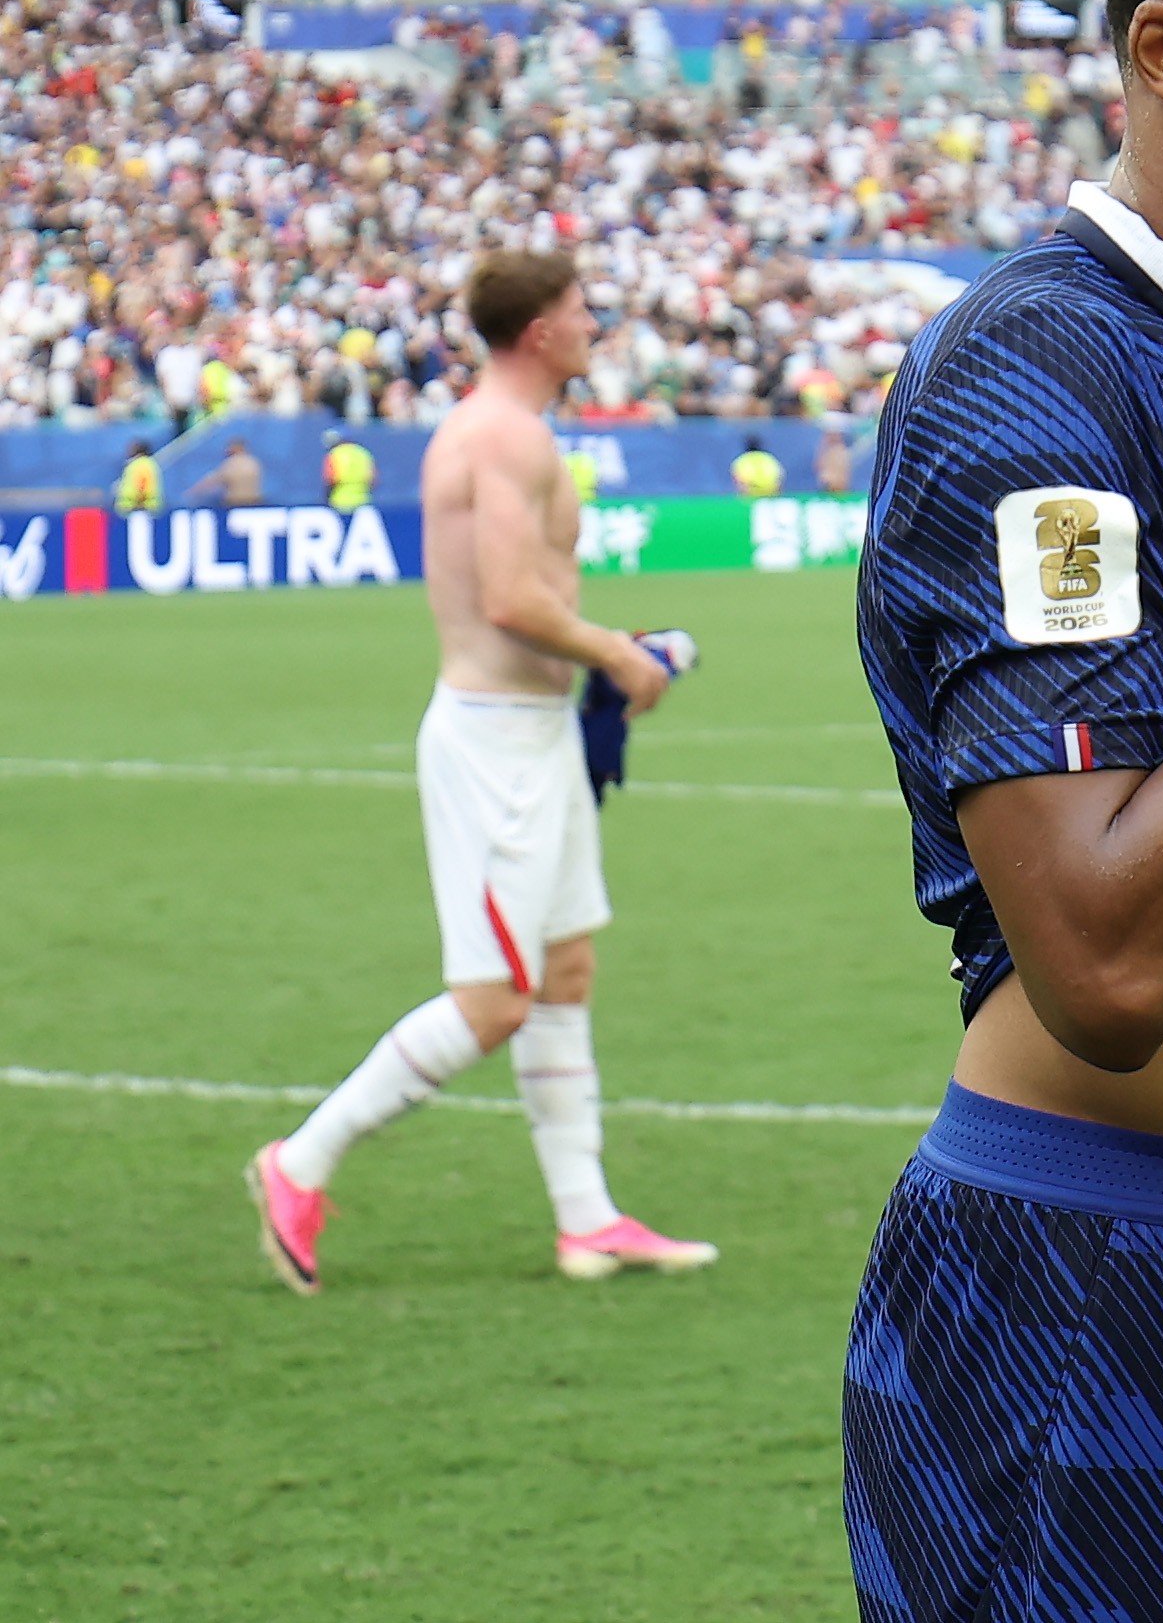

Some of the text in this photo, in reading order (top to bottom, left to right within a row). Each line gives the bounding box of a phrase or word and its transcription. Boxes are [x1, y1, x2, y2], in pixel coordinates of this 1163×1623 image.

[126, 506, 400, 595] ULTRA
[1057, 578, 1088, 593] FIFA
[1043, 601, 1105, 616] WORLD CUP
[1043, 613, 1109, 632] 2026
